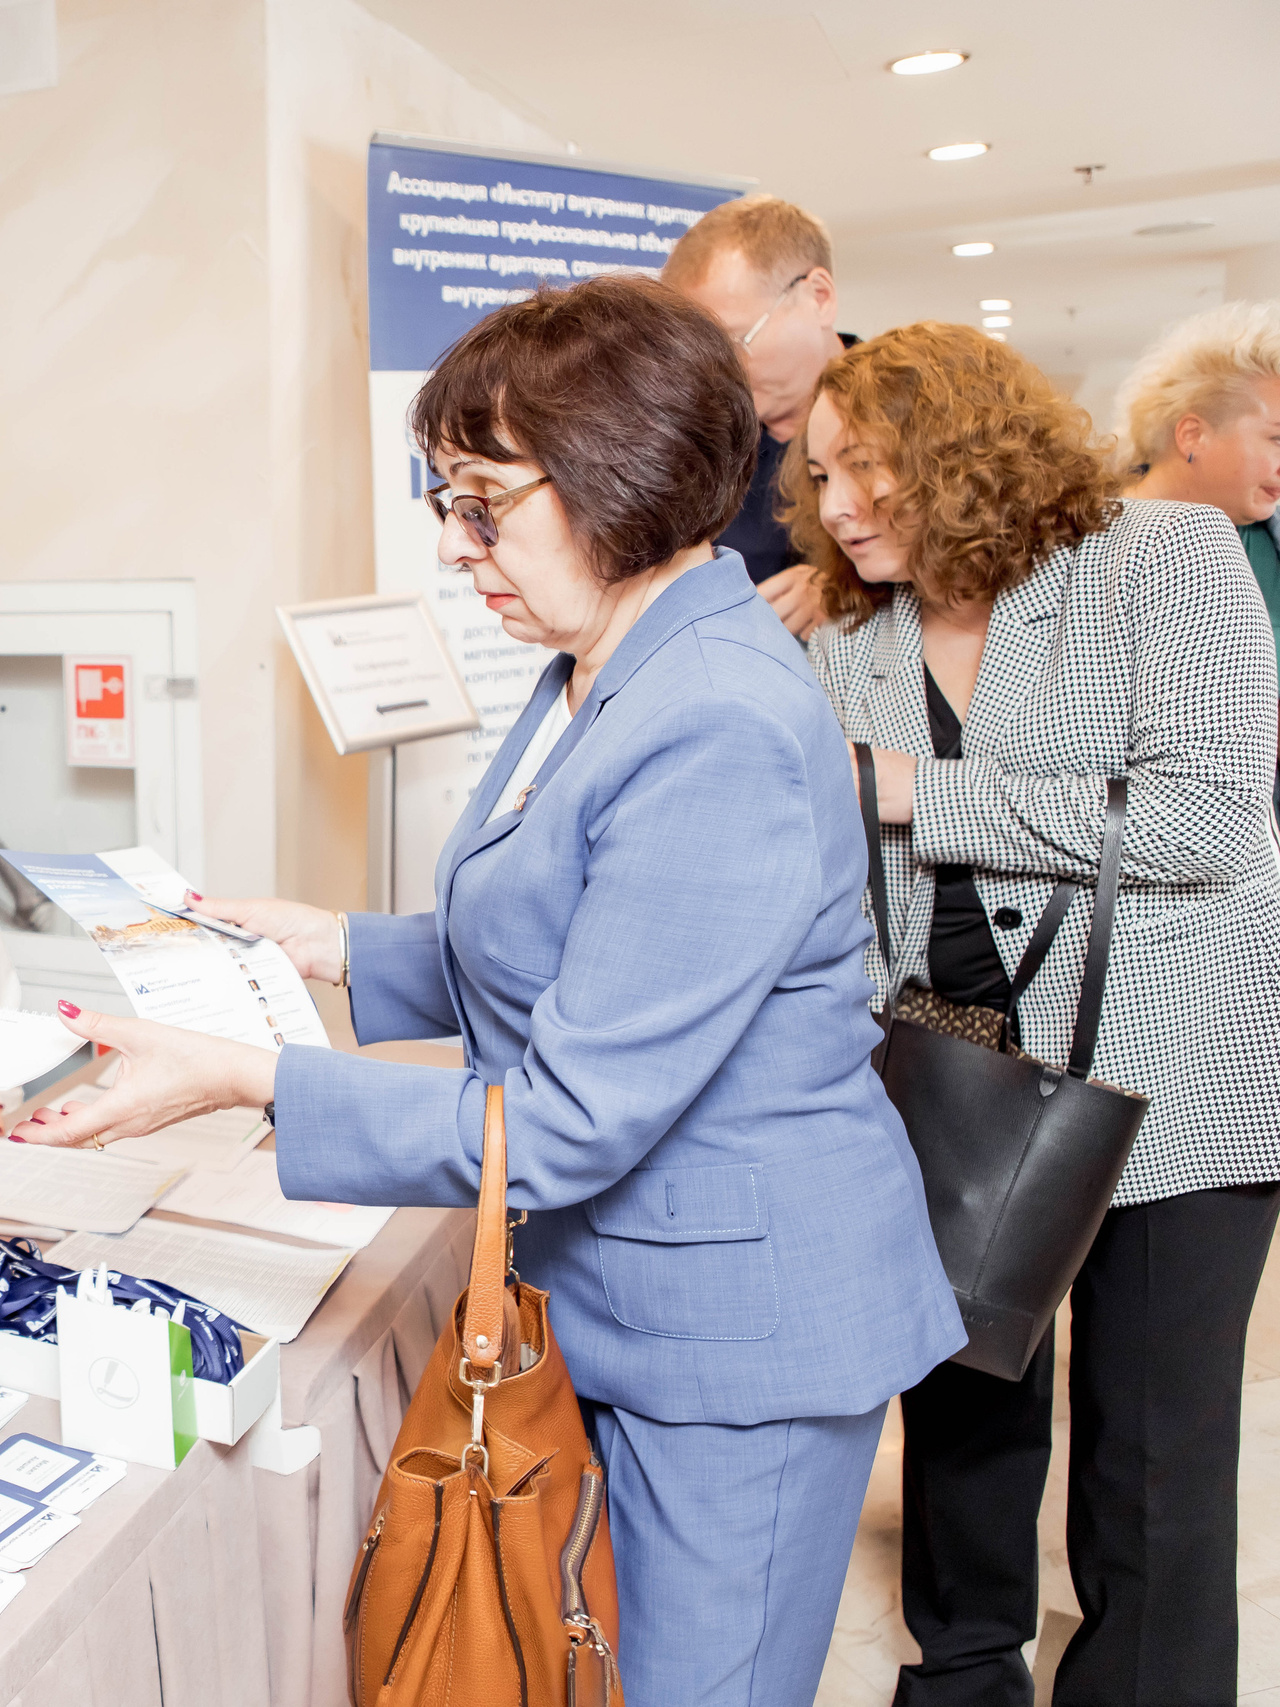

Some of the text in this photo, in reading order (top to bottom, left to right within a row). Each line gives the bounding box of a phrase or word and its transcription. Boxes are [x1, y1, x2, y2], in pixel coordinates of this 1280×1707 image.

[387, 171, 488, 203] Ассоциация
[490, 181, 566, 214] «Институт
[567, 194, 646, 219] внутренних
[501, 218, 638, 250] профессиональное
[393, 248, 488, 272] внутренних
